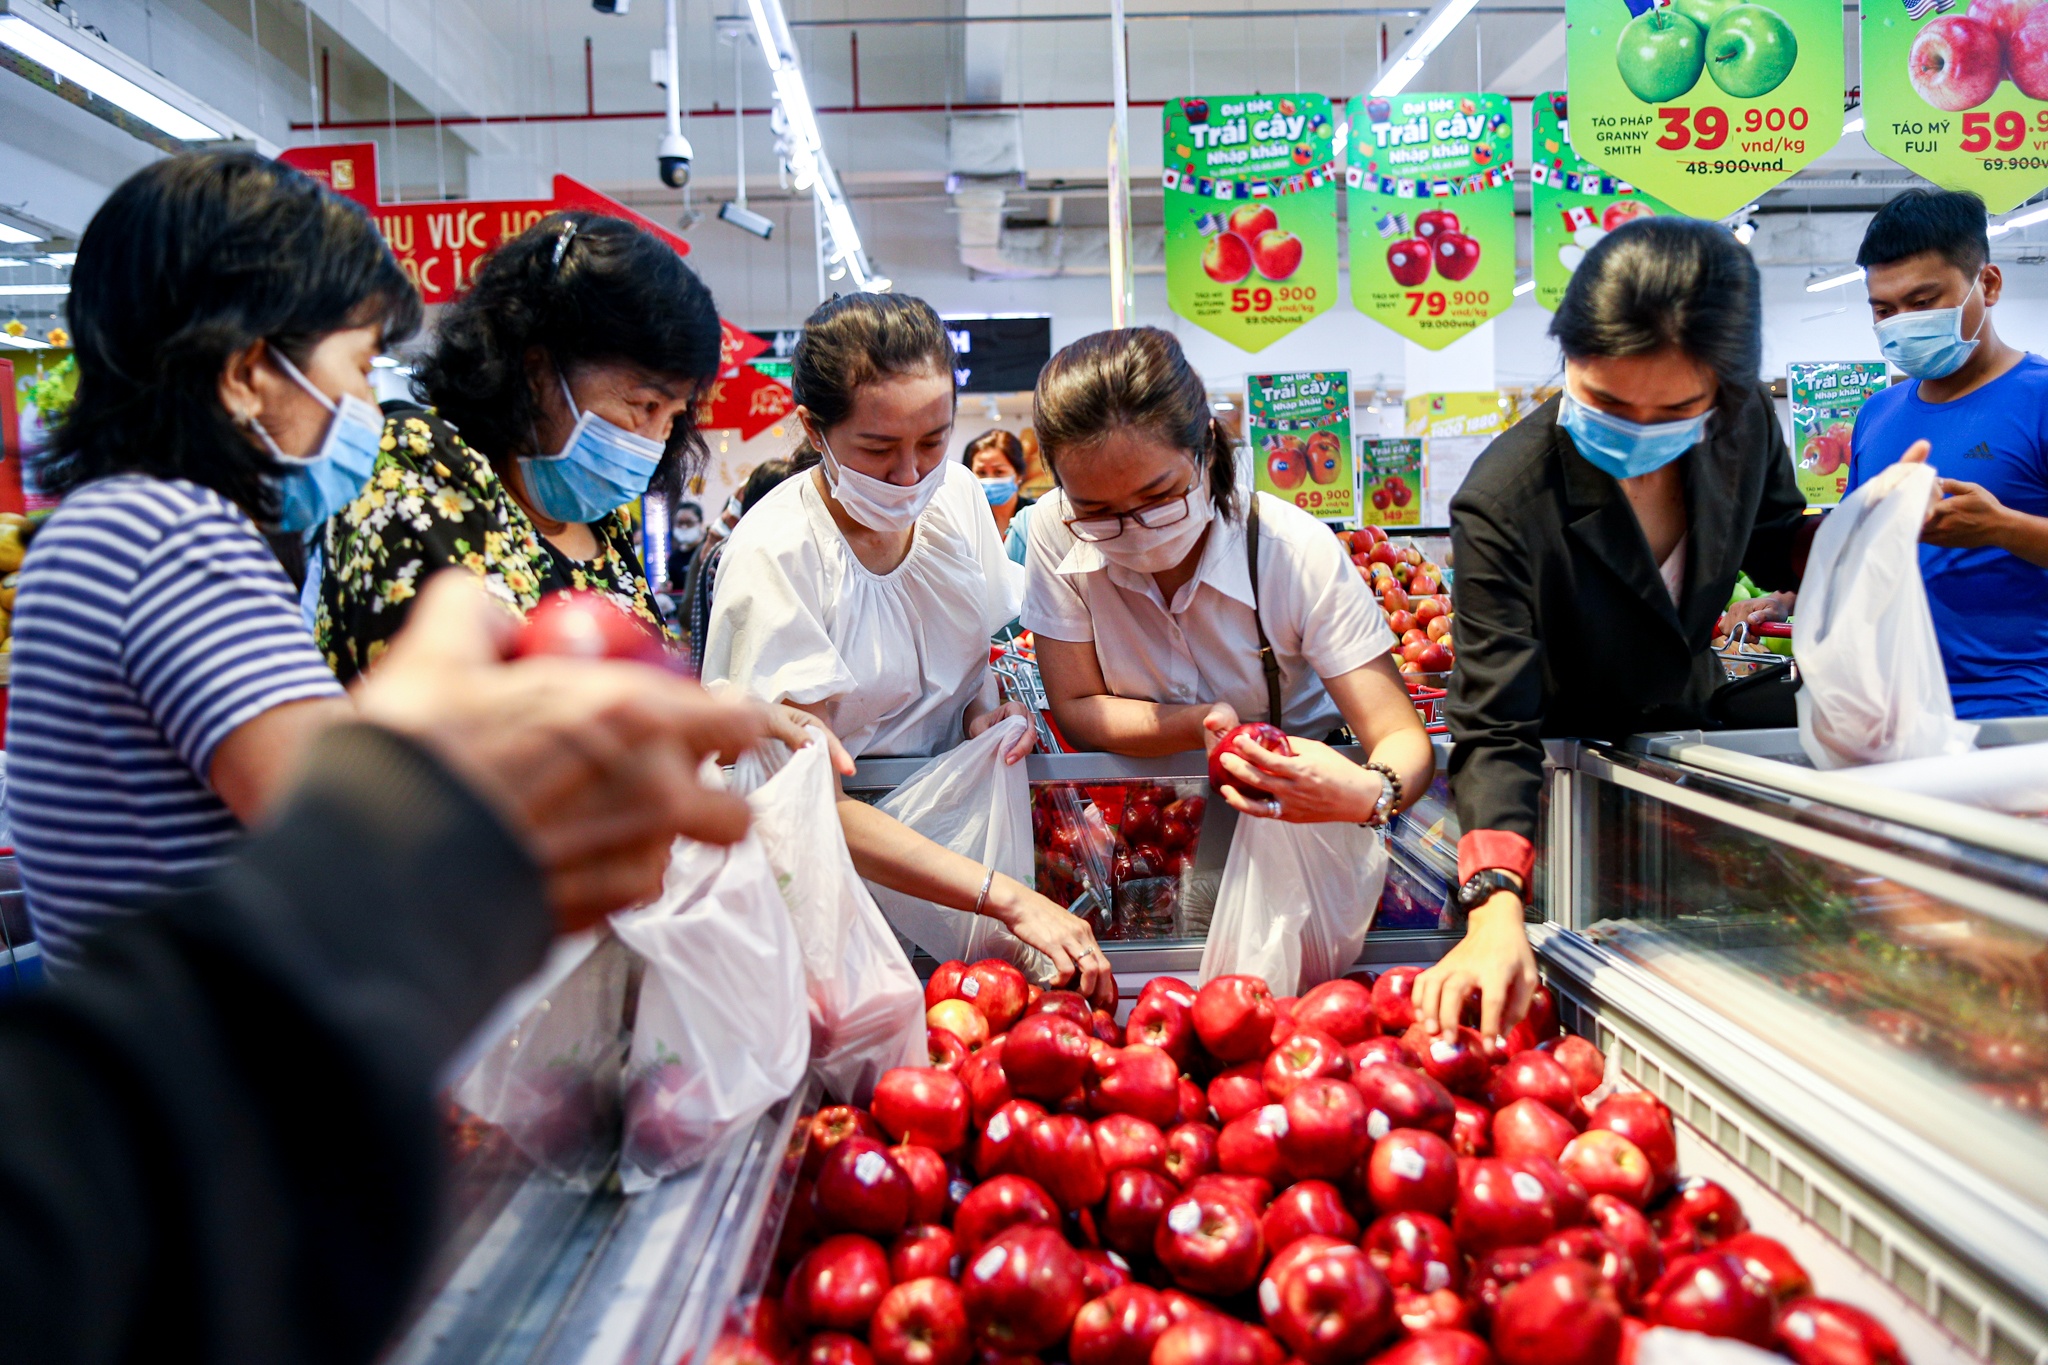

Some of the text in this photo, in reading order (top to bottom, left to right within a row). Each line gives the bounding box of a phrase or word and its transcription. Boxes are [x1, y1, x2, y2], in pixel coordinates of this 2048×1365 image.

[1591, 114, 1653, 127] TÁO PHÁP
[1892, 119, 1950, 135] TÁO MỸ
[1189, 112, 1306, 148] Trái cây
[1371, 112, 1486, 148] Trái cây
[1596, 130, 1649, 142] GRANNY
[1389, 140, 1469, 165] Nhập khẩu
[1604, 145, 1641, 156] SMITH
[1741, 136, 1805, 153] vnd/kg
[1905, 141, 1938, 153] FUJI
[1207, 141, 1289, 166] Nhập khẩu
[1685, 158, 1783, 175] 48.900vnd
[1805, 371, 1870, 391] Trái cây
[1261, 379, 1331, 402] Trái cây
